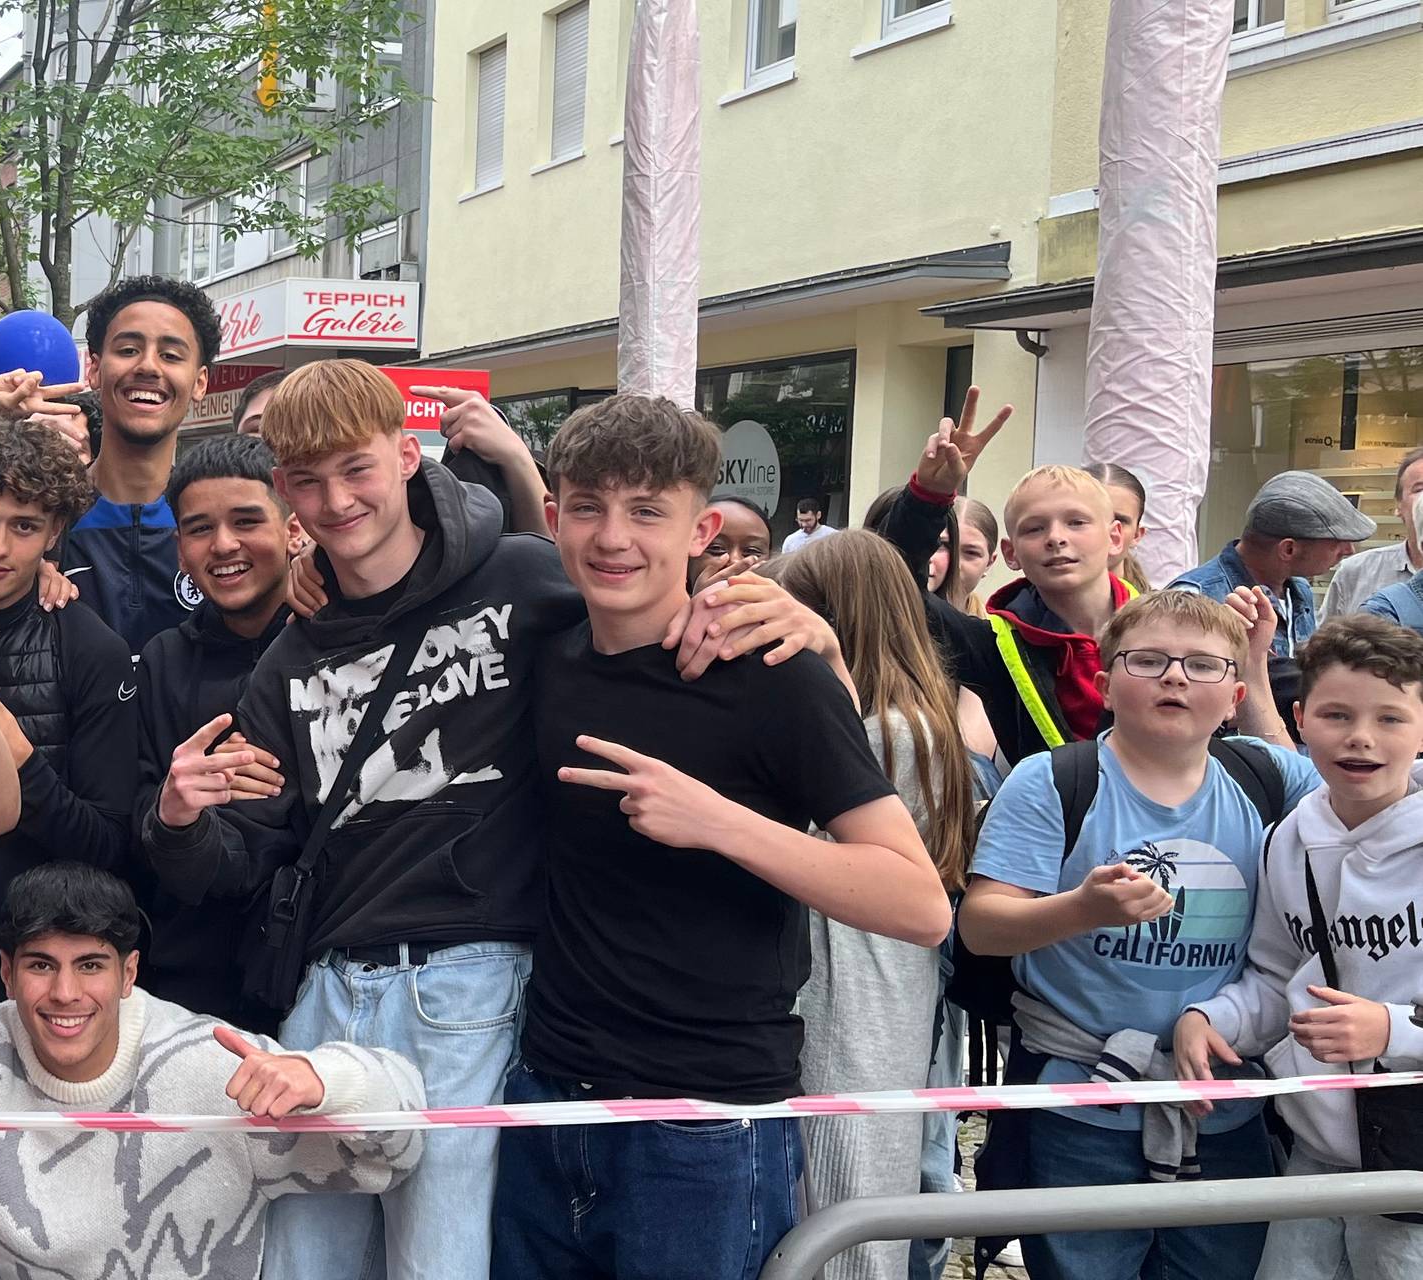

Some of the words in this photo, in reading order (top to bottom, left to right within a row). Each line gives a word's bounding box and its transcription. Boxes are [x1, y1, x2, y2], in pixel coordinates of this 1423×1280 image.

[303, 291, 406, 308] TEPPICH
[303, 308, 406, 336] Galerie
[403, 401, 447, 418] ICHT
[1093, 933, 1237, 968] CALIFORNIA
